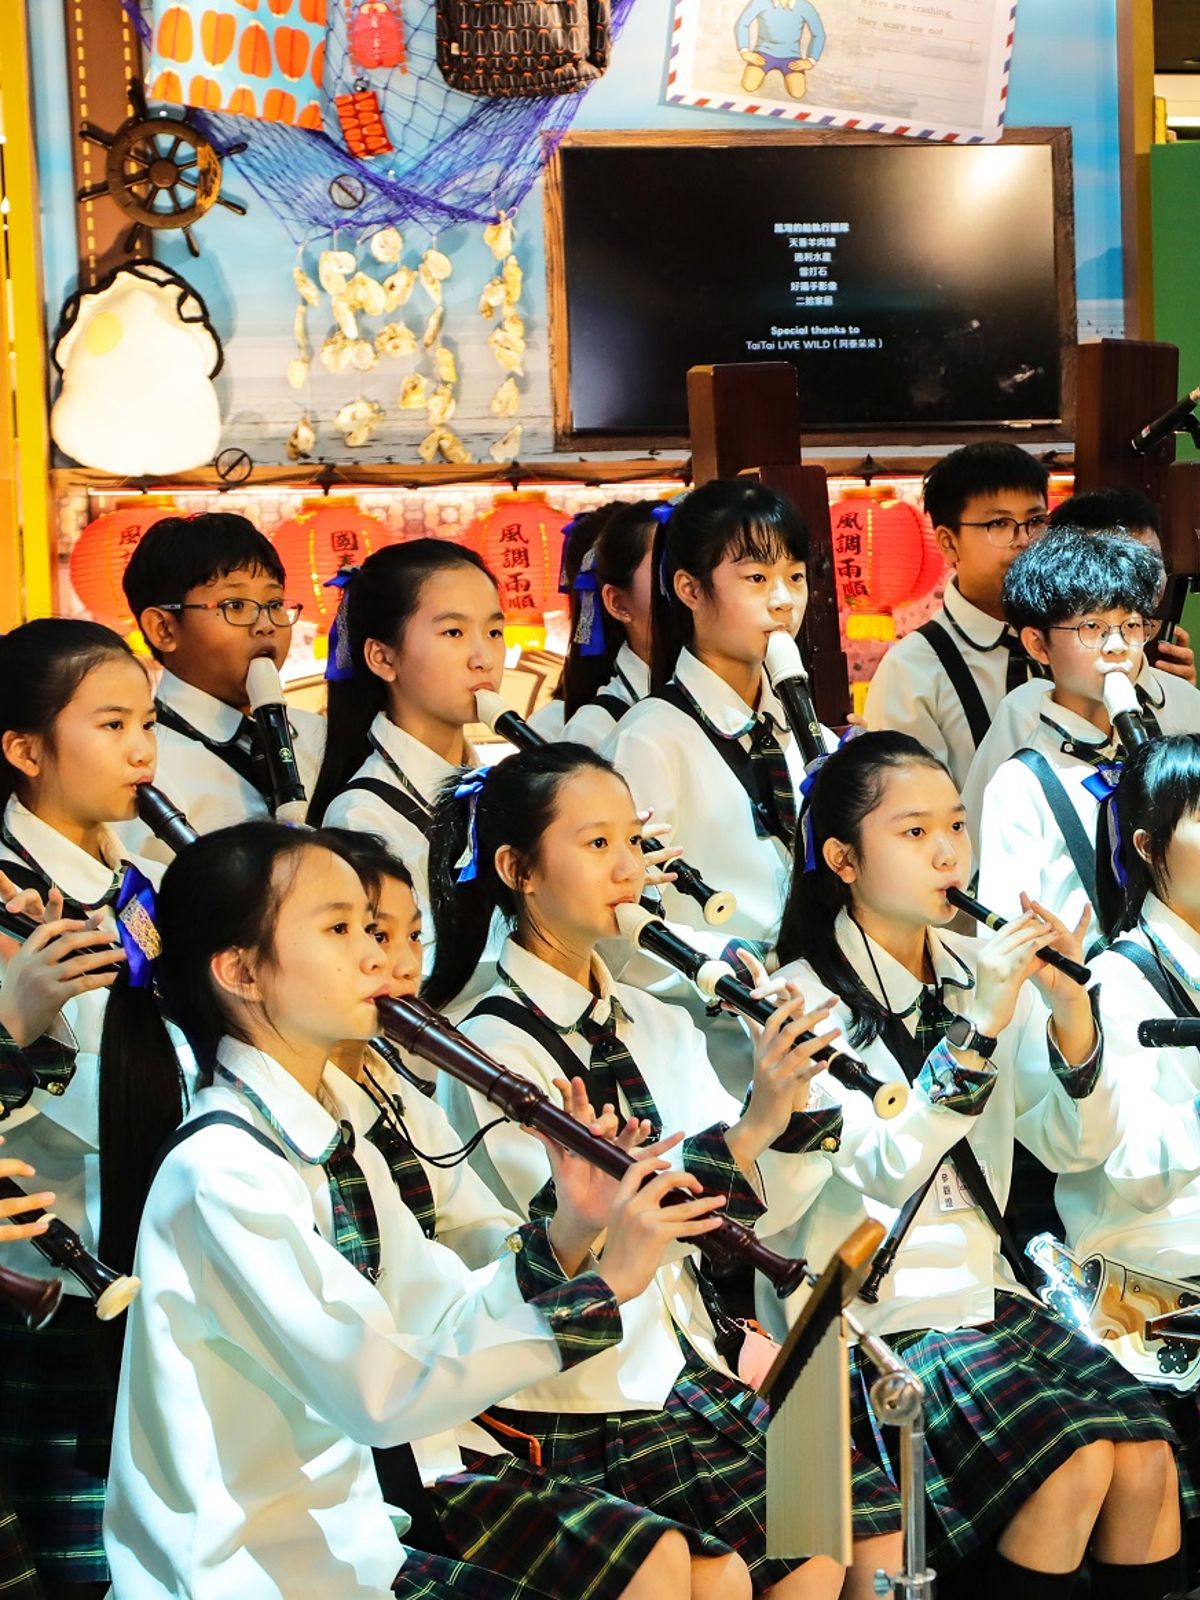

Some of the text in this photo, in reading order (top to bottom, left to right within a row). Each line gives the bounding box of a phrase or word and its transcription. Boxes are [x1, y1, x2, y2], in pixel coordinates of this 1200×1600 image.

[746, 341, 775, 350] TaiTai
[778, 340, 800, 350] LIVE
[803, 340, 831, 349] WILD
[770, 324, 860, 337] Special thanks to
[499, 523, 537, 610] 風調雨順
[836, 512, 869, 598] 風調雨順
